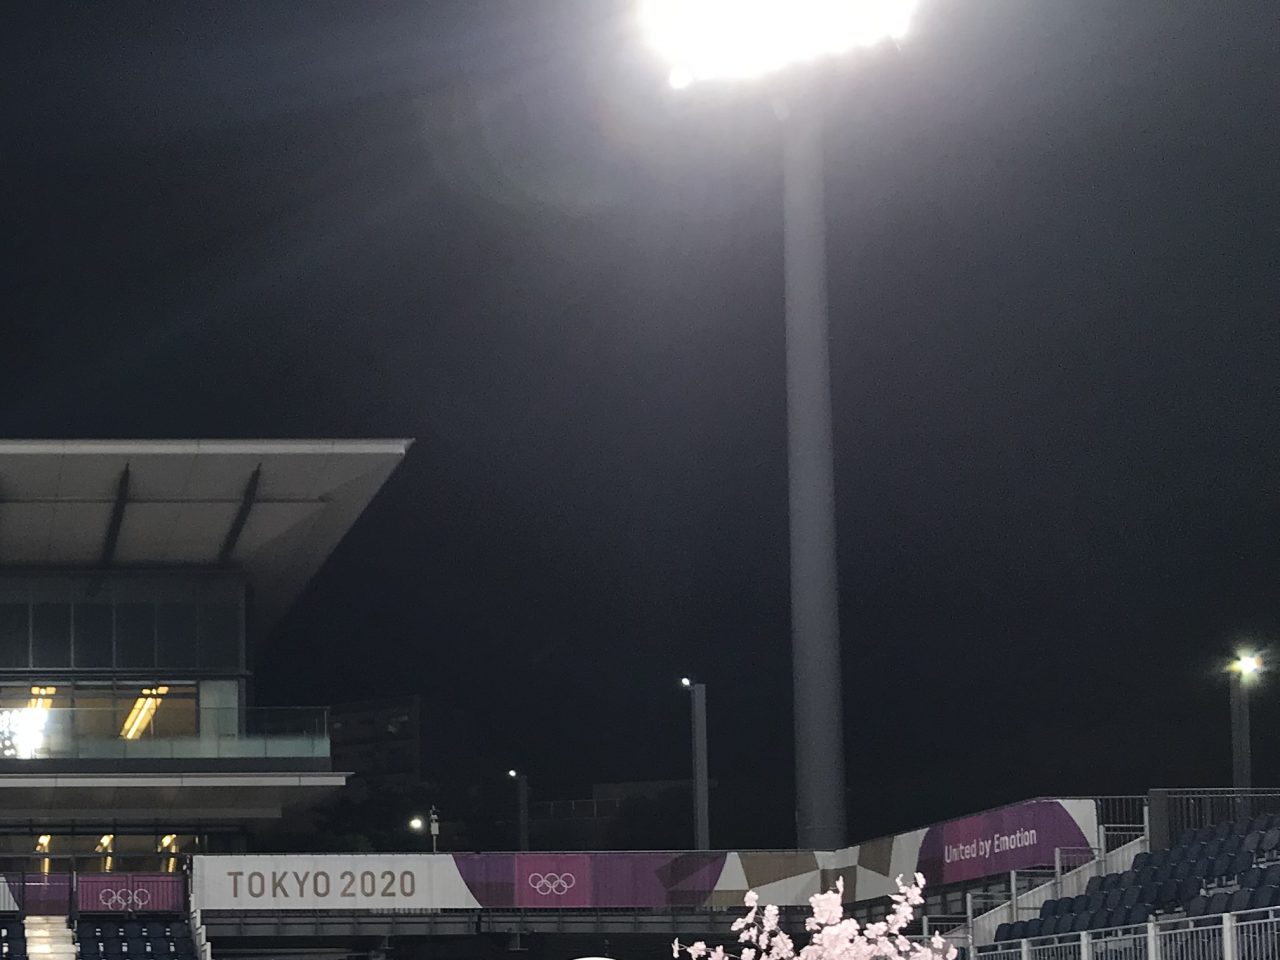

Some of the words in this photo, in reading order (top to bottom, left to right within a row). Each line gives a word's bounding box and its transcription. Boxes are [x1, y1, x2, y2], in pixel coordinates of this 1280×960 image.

[944, 838, 977, 863] United
[979, 837, 992, 858] by
[994, 827, 1038, 853] Emotion
[227, 871, 330, 898] TOKYO
[339, 870, 416, 898] 2020
